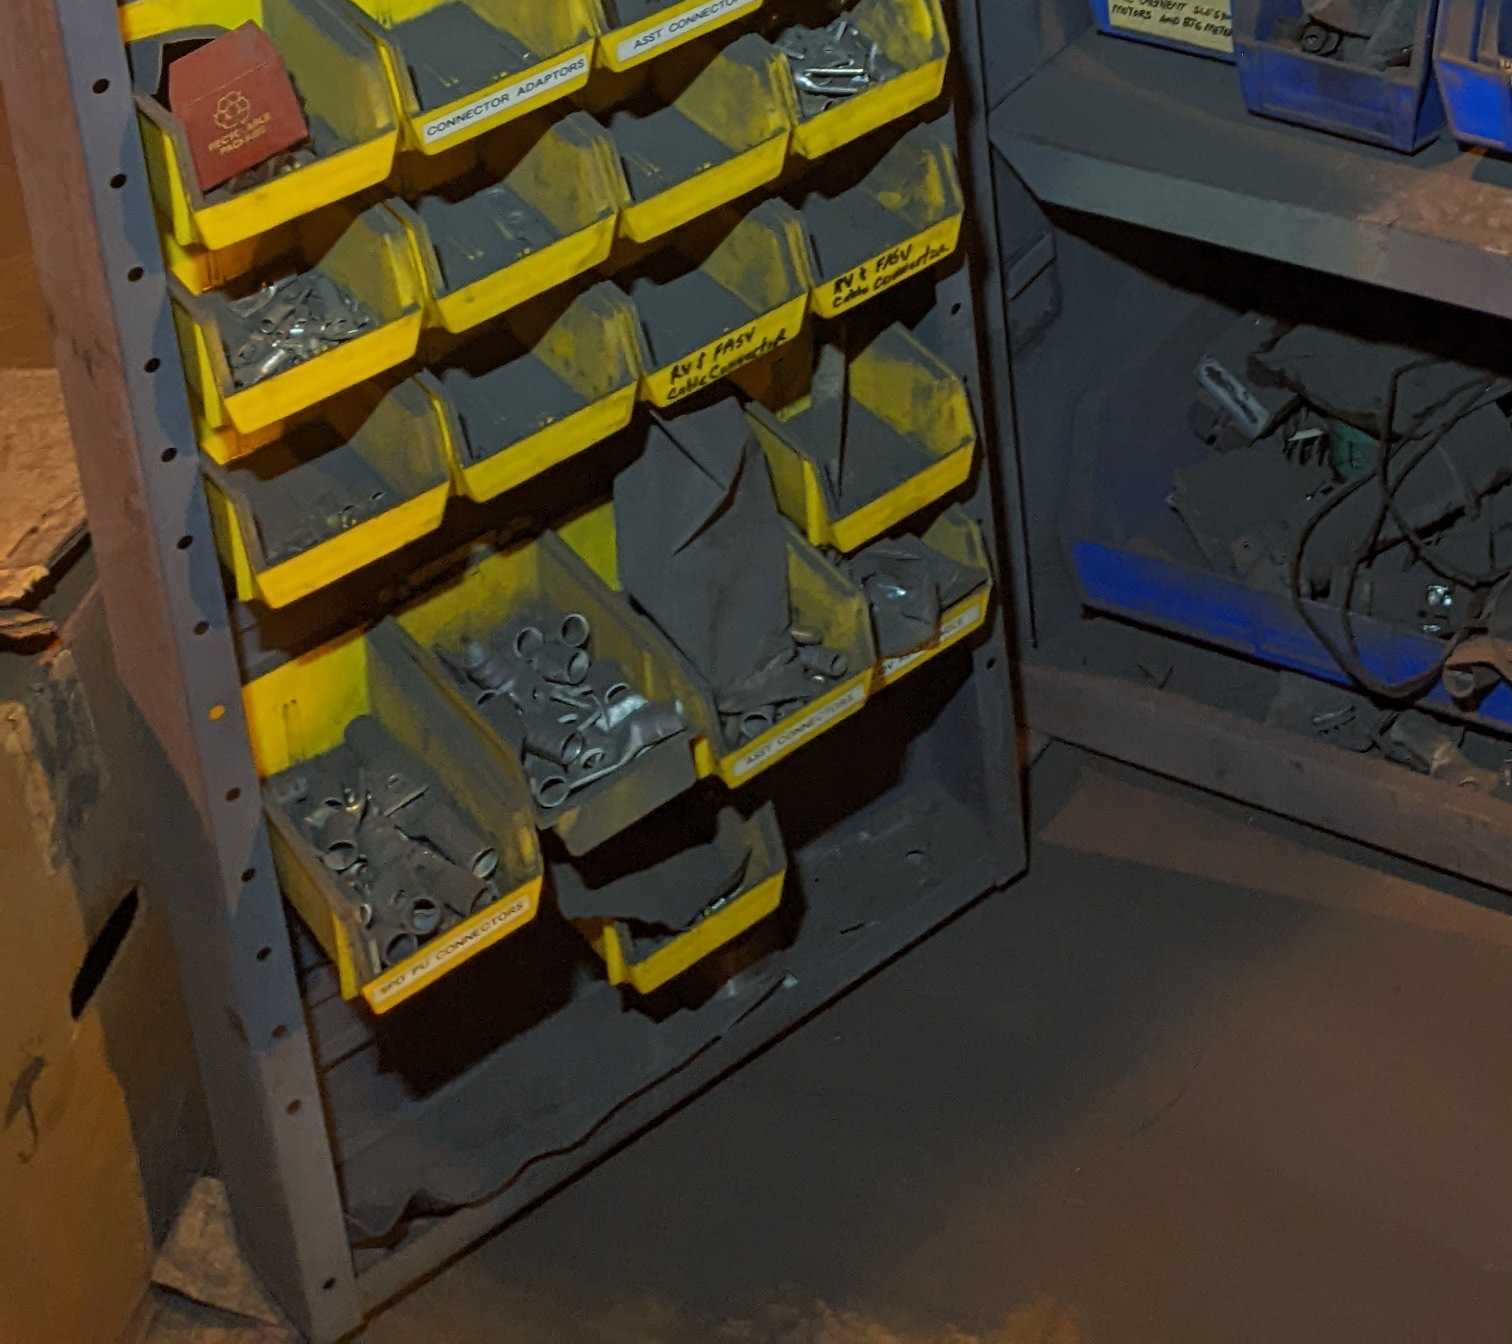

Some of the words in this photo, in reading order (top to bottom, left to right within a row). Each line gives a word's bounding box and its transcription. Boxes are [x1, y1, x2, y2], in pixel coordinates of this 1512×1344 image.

[633, 28, 663, 51] ASST
[426, 91, 511, 138] CONNECTOR
[517, 57, 586, 97] ADAPTORS
